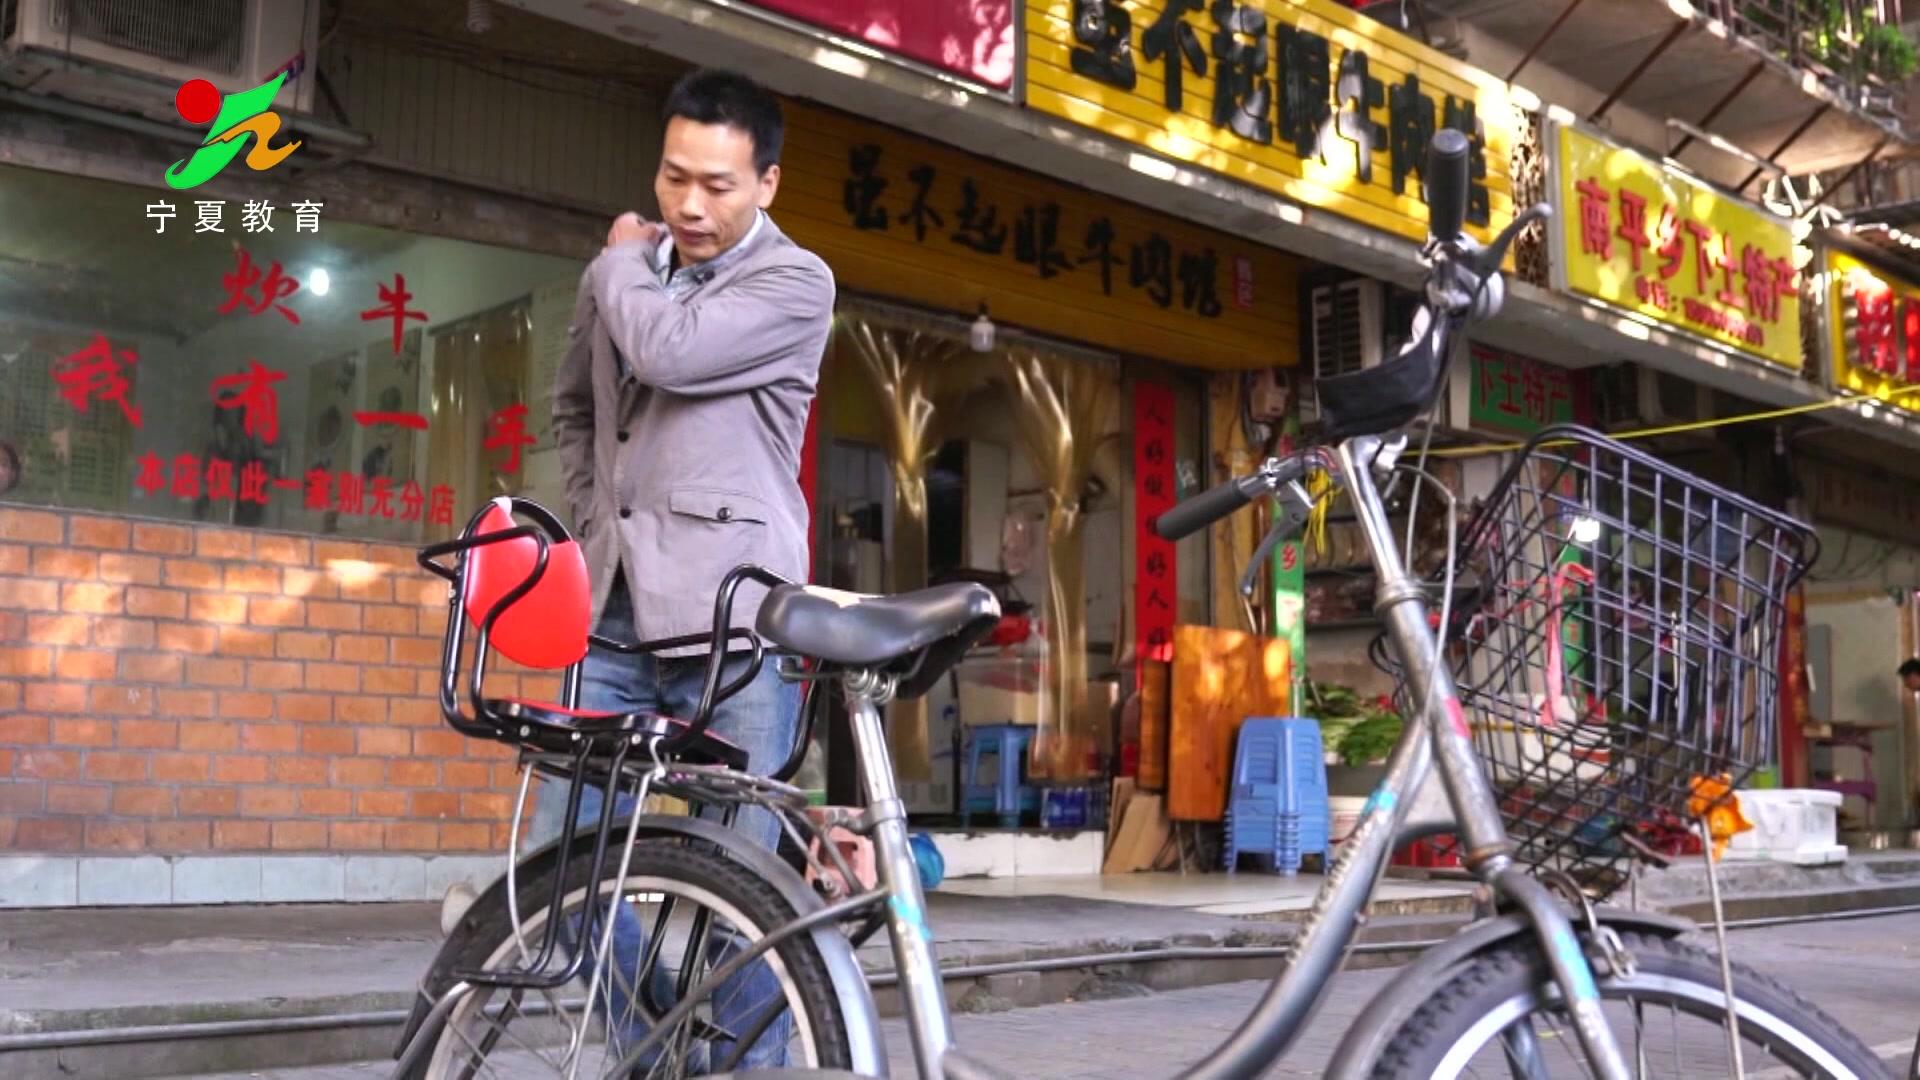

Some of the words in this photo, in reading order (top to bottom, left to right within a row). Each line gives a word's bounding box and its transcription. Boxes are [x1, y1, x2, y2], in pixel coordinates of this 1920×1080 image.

[1576, 177, 1798, 324] 南平乡下土特产
[51, 333, 537, 475] 我有一手
[1472, 346, 1568, 424] 下土特产
[134, 450, 456, 525] 本店仅此一家别无分店
